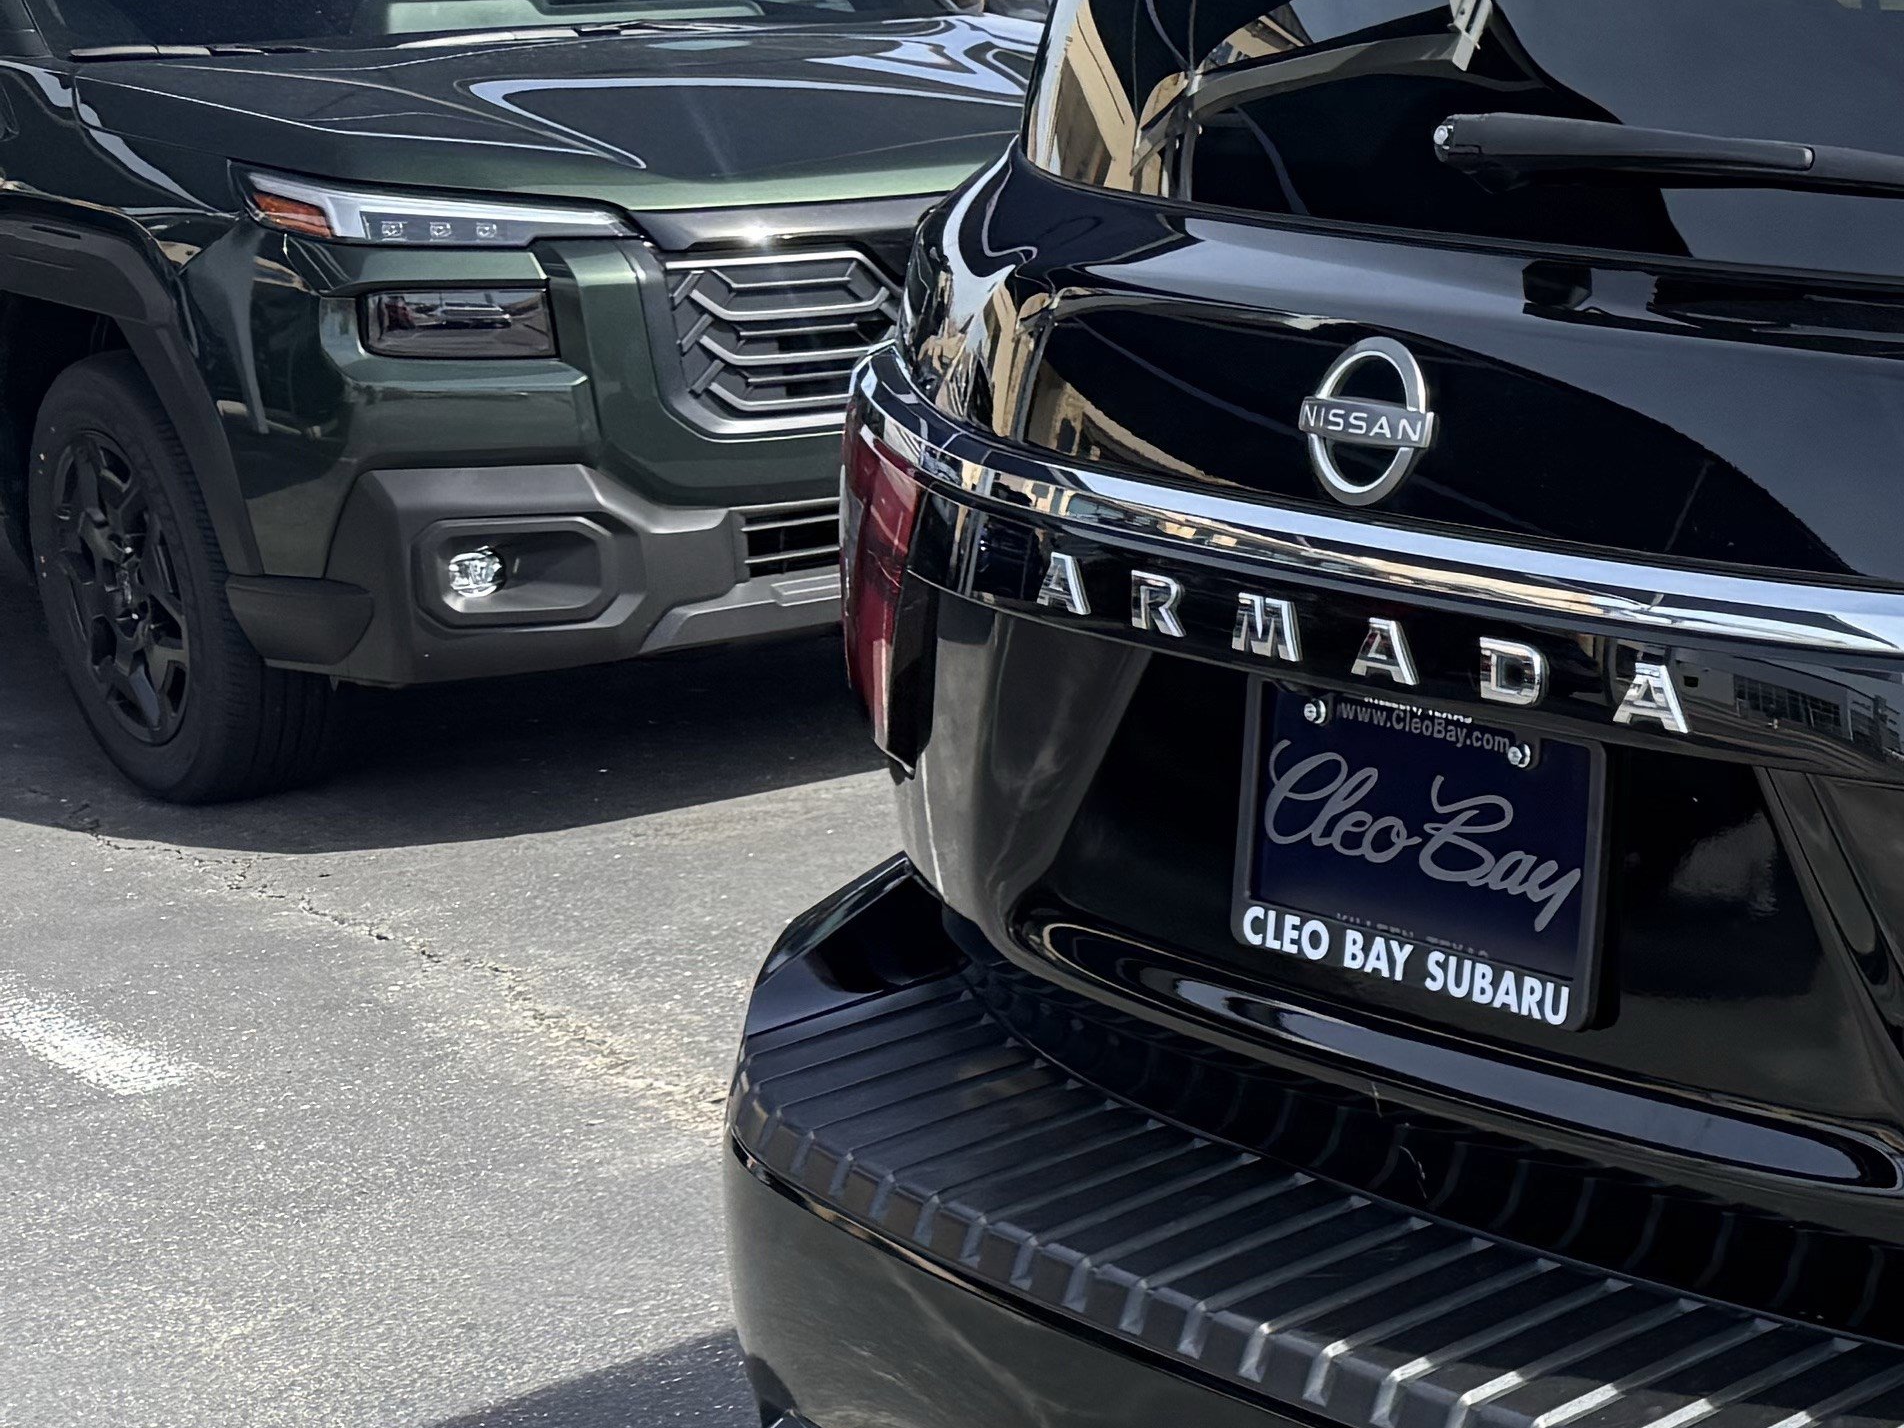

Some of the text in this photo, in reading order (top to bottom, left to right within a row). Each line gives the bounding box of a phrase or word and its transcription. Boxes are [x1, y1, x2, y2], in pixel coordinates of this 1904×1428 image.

[1301, 404, 1423, 442] NISSAN
[1036, 551, 1690, 733] ARMADA
[1338, 701, 1511, 754] www.CleoBay.com
[1264, 738, 1582, 933] Cleo Bay
[1242, 905, 1330, 961] CLEO
[1342, 928, 1415, 982] BAY
[1423, 950, 1570, 1026] SUBARU
